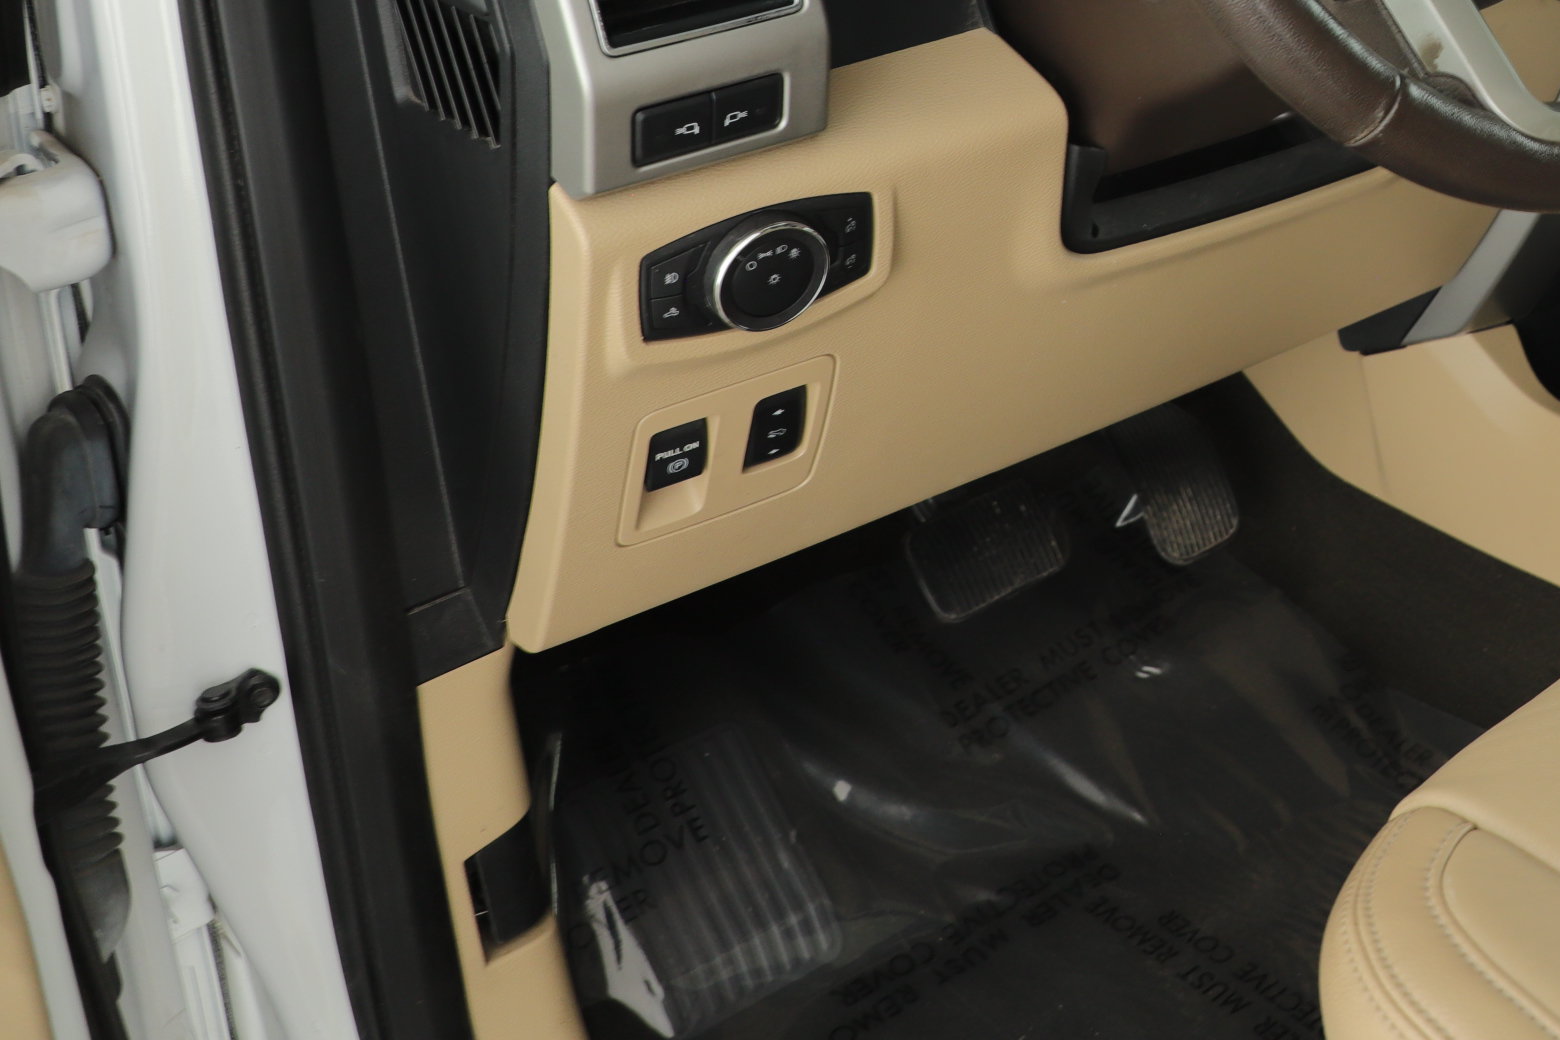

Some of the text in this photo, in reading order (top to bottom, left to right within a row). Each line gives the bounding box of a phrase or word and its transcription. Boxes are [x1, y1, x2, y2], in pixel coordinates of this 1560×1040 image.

[655, 440, 700, 461] PULL ON
[939, 616, 1104, 729] DEALER MUST
[1084, 894, 1182, 965] REMOVE
[1157, 908, 1236, 964] COVER
[828, 941, 937, 1007] COVER
[1175, 963, 1254, 1015] MUST
